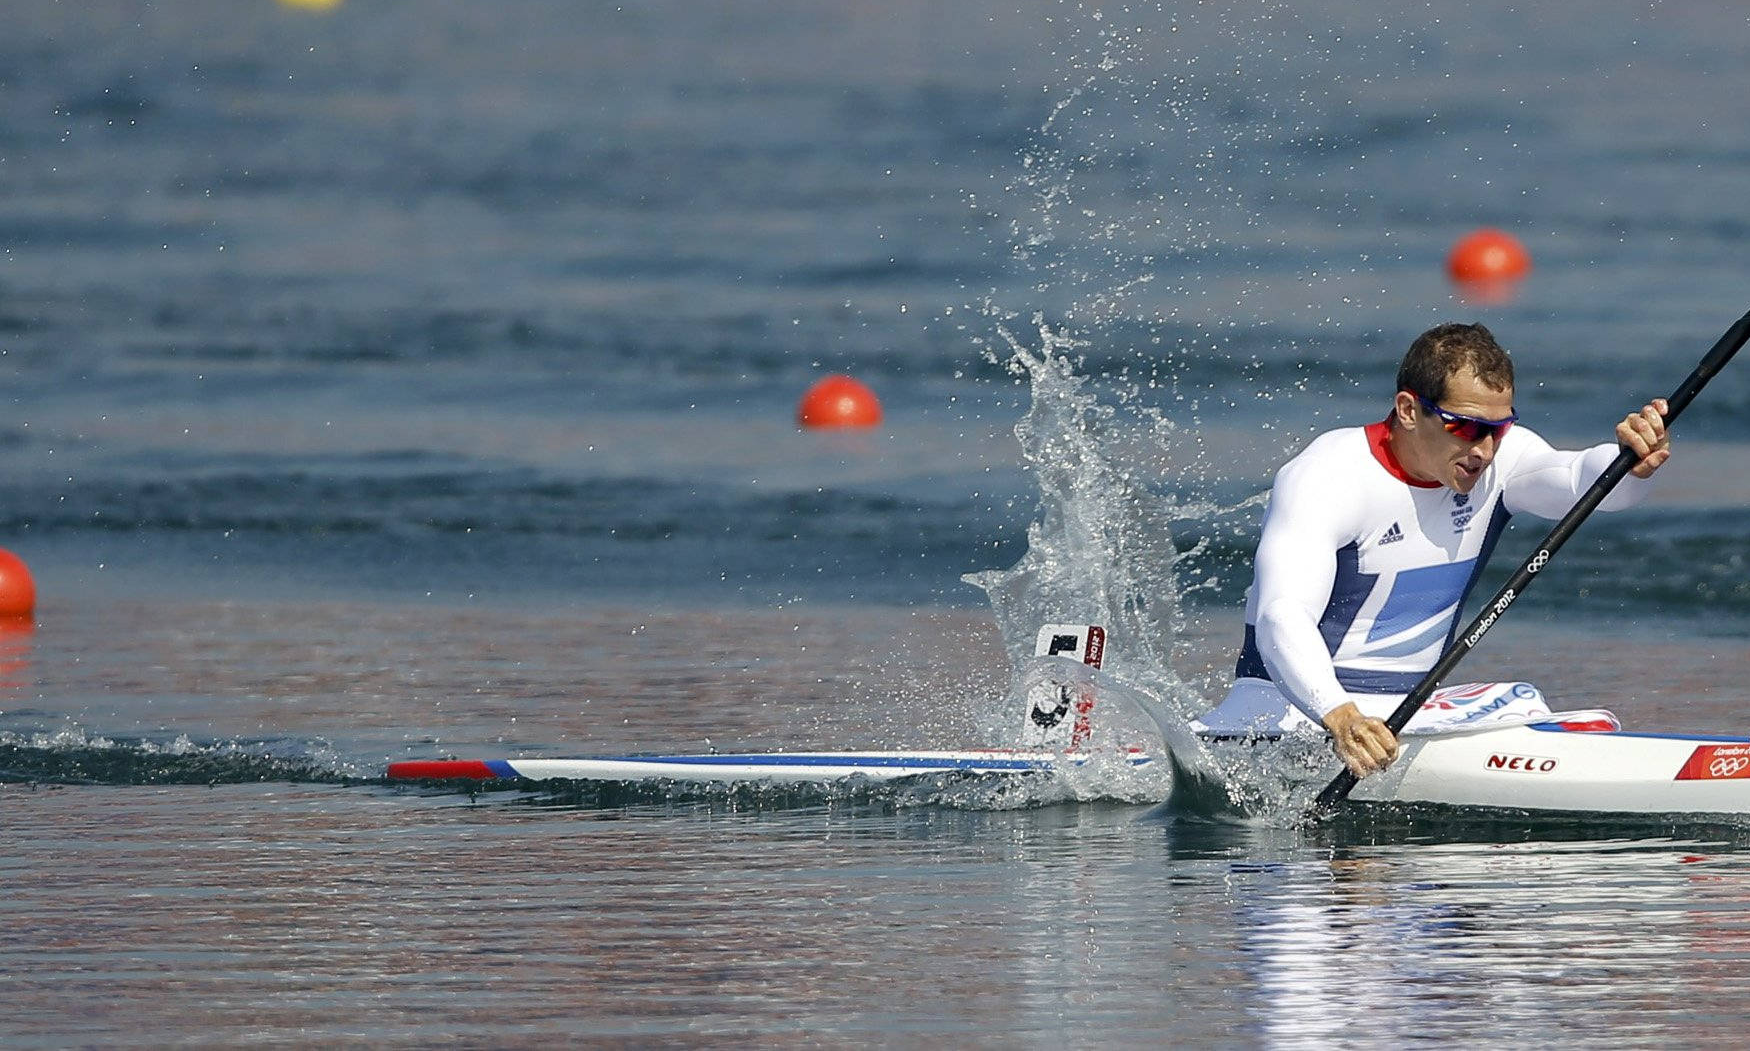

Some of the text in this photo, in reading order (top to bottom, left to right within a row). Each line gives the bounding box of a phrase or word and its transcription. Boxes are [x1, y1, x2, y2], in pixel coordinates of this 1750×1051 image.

[1464, 588, 1516, 648] London 2012
[1712, 747, 1742, 757] London
[1487, 754, 1556, 772] NELO
